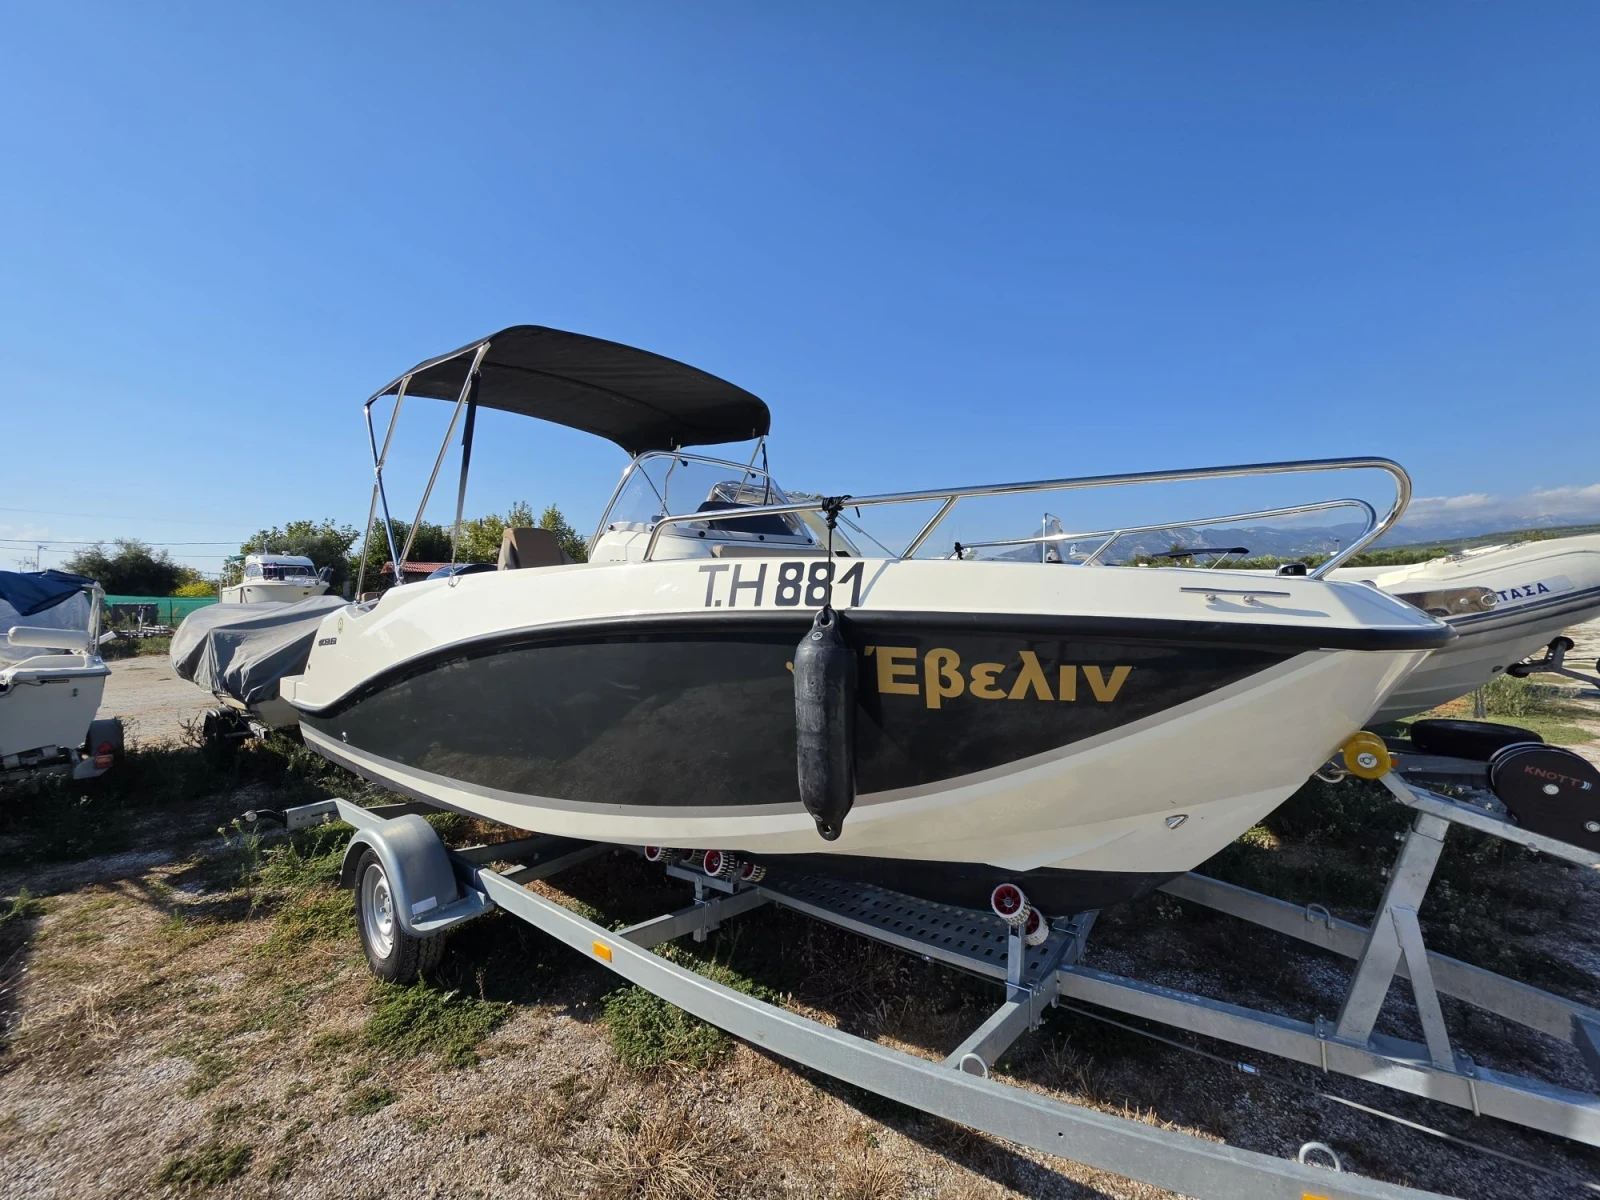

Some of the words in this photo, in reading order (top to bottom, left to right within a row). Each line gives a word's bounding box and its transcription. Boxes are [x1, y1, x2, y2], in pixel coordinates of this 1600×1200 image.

[775, 561, 865, 607] 881
[1496, 582, 1550, 603] ΤΑΣΑ
[1524, 765, 1581, 787] KNOTT
